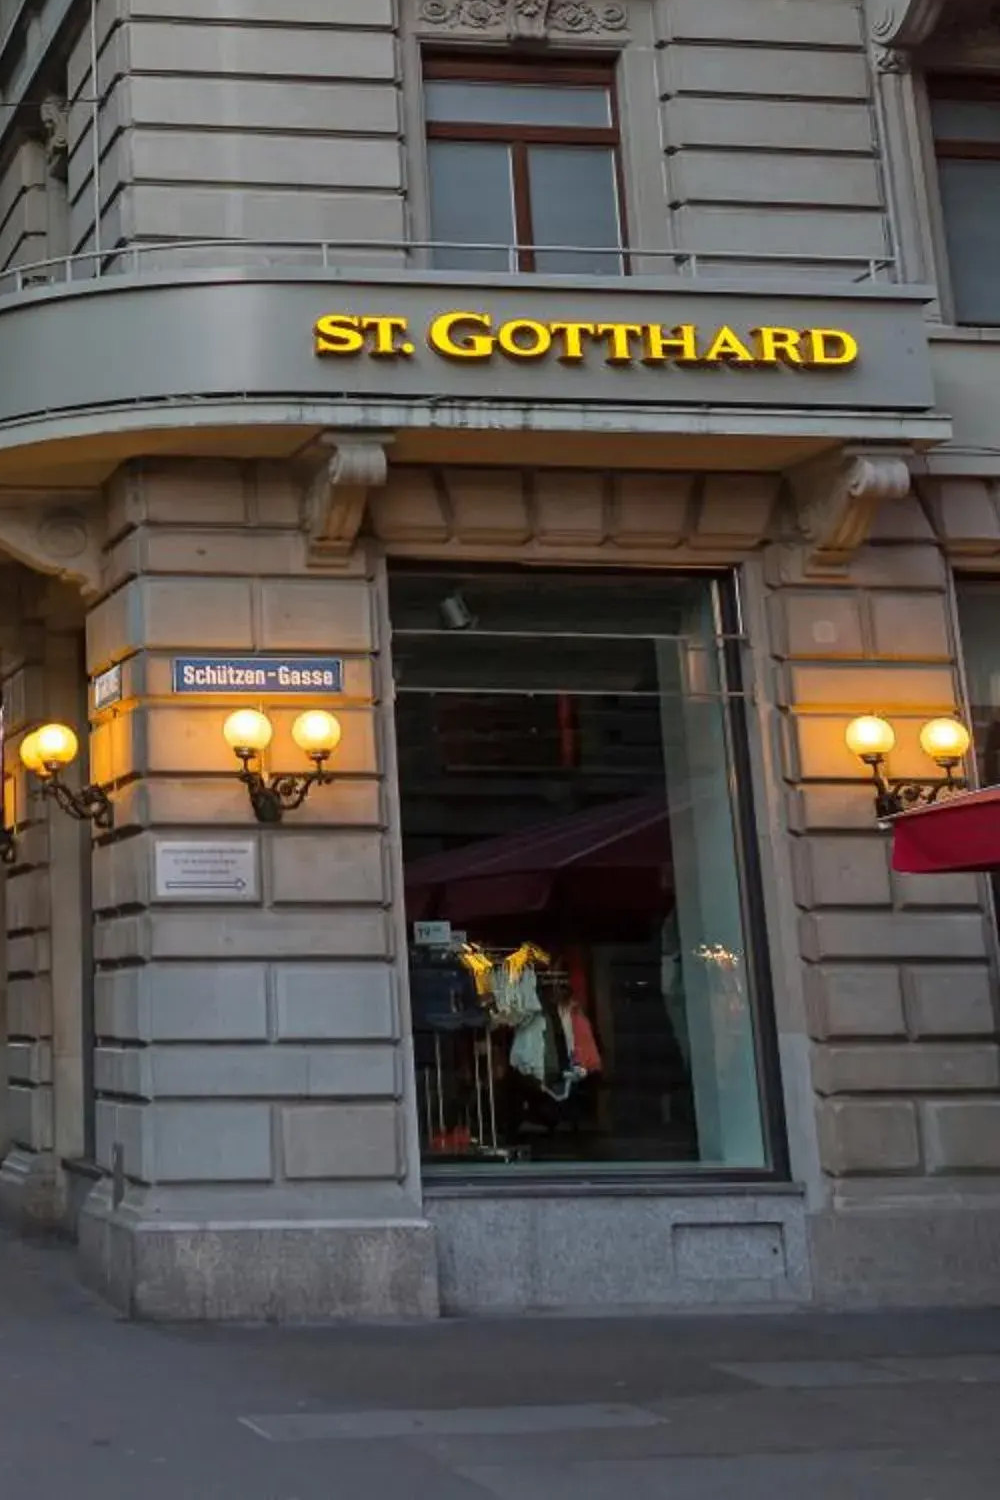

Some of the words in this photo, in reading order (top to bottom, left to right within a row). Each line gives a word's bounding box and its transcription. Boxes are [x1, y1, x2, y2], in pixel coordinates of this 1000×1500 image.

[315, 313, 415, 358] ST.
[428, 311, 859, 367] GOTTHARD
[183, 665, 334, 686] Schützen-Gasse
